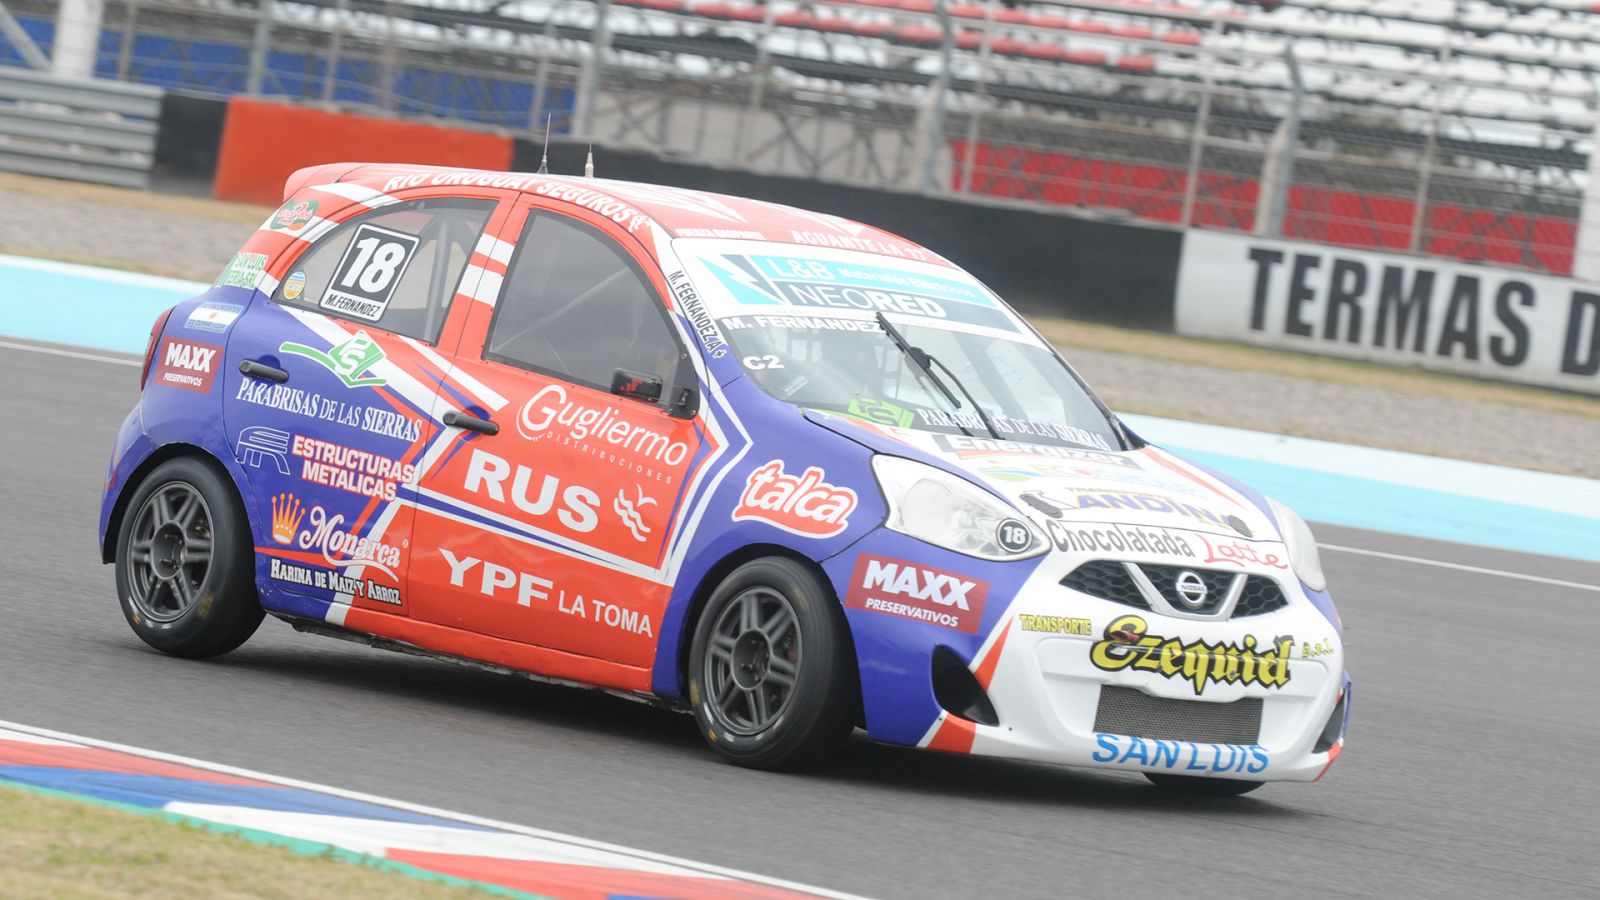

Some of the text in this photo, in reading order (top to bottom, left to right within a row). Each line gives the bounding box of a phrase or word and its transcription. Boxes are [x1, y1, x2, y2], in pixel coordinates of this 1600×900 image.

[383, 171, 633, 224] RIO URUGUAY SEGUROS
[790, 229, 879, 253] AGUANTE
[876, 241, 906, 258] LA
[341, 237, 406, 294] 18
[668, 270, 685, 285] M.
[766, 257, 837, 281] L&B
[675, 282, 718, 342] FERNANDEZ
[788, 283, 947, 319] NEORED
[1246, 245, 1600, 377] TERMAS D
[721, 315, 888, 334] M. FERNANDEZ
[163, 372, 204, 387] PRESERVATIVOS
[164, 342, 217, 374] MAXX
[742, 354, 785, 371] C2
[236, 377, 423, 443] PARABRISAS DE LAS SIERRAS
[521, 384, 688, 467] Gugliermo
[916, 408, 1014, 434] PARABRIAS
[1014, 418, 1031, 434] DE
[1029, 420, 1058, 440] LAS
[1054, 423, 1112, 451] SIERRAS
[292, 434, 416, 484] ESTRUCTURAS
[546, 430, 673, 485] DISTRIBUCIONES
[953, 437, 1135, 469] Energizer
[302, 459, 398, 501] METALICAS
[463, 448, 601, 533] RUS
[745, 467, 851, 524] talca
[1077, 494, 1232, 529] ANDIN
[299, 506, 400, 575] Monarca
[1003, 526, 1027, 544] 18
[1045, 518, 1290, 570] Chocolatada Latte
[270, 558, 403, 606] HARINA DE MAIZ Y ARROZ
[438, 547, 653, 638] YPF LA TOMA
[863, 560, 977, 612] MAXX
[865, 598, 959, 628] PRESERVATIVOS
[1019, 613, 1093, 636] TRANSPORTE
[1091, 733, 1271, 775] SAN LUIS
